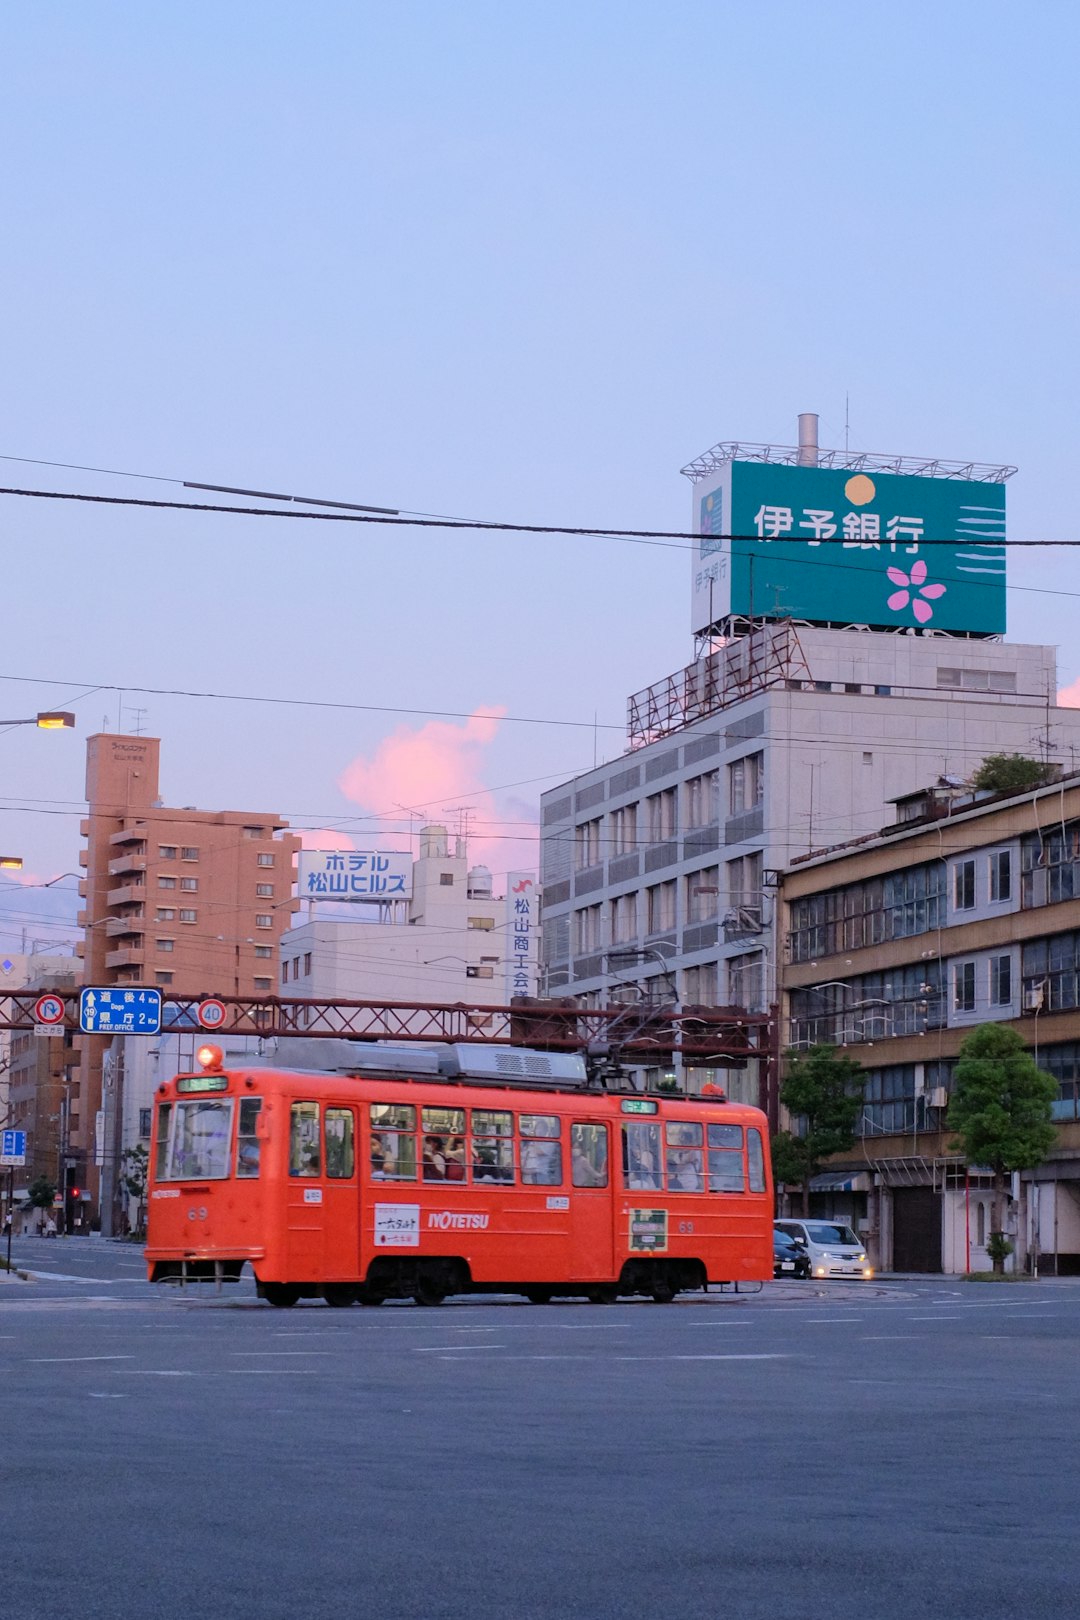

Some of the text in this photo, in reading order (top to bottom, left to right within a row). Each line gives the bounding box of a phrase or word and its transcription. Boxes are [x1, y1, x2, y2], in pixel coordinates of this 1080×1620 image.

[753, 504, 924, 554] 伊予銀行
[695, 557, 727, 593] 伊予銀行
[326, 854, 389, 871] ホテル
[308, 872, 407, 893] 松山ヒルズ
[139, 992, 145, 1003] 4
[86, 1008, 95, 1016] 19
[111, 1003, 124, 1011] Dogo
[204, 1007, 219, 1020] 40
[139, 1013, 145, 1024] 2
[187, 1206, 208, 1221] 69
[679, 1221, 693, 1233] 69
